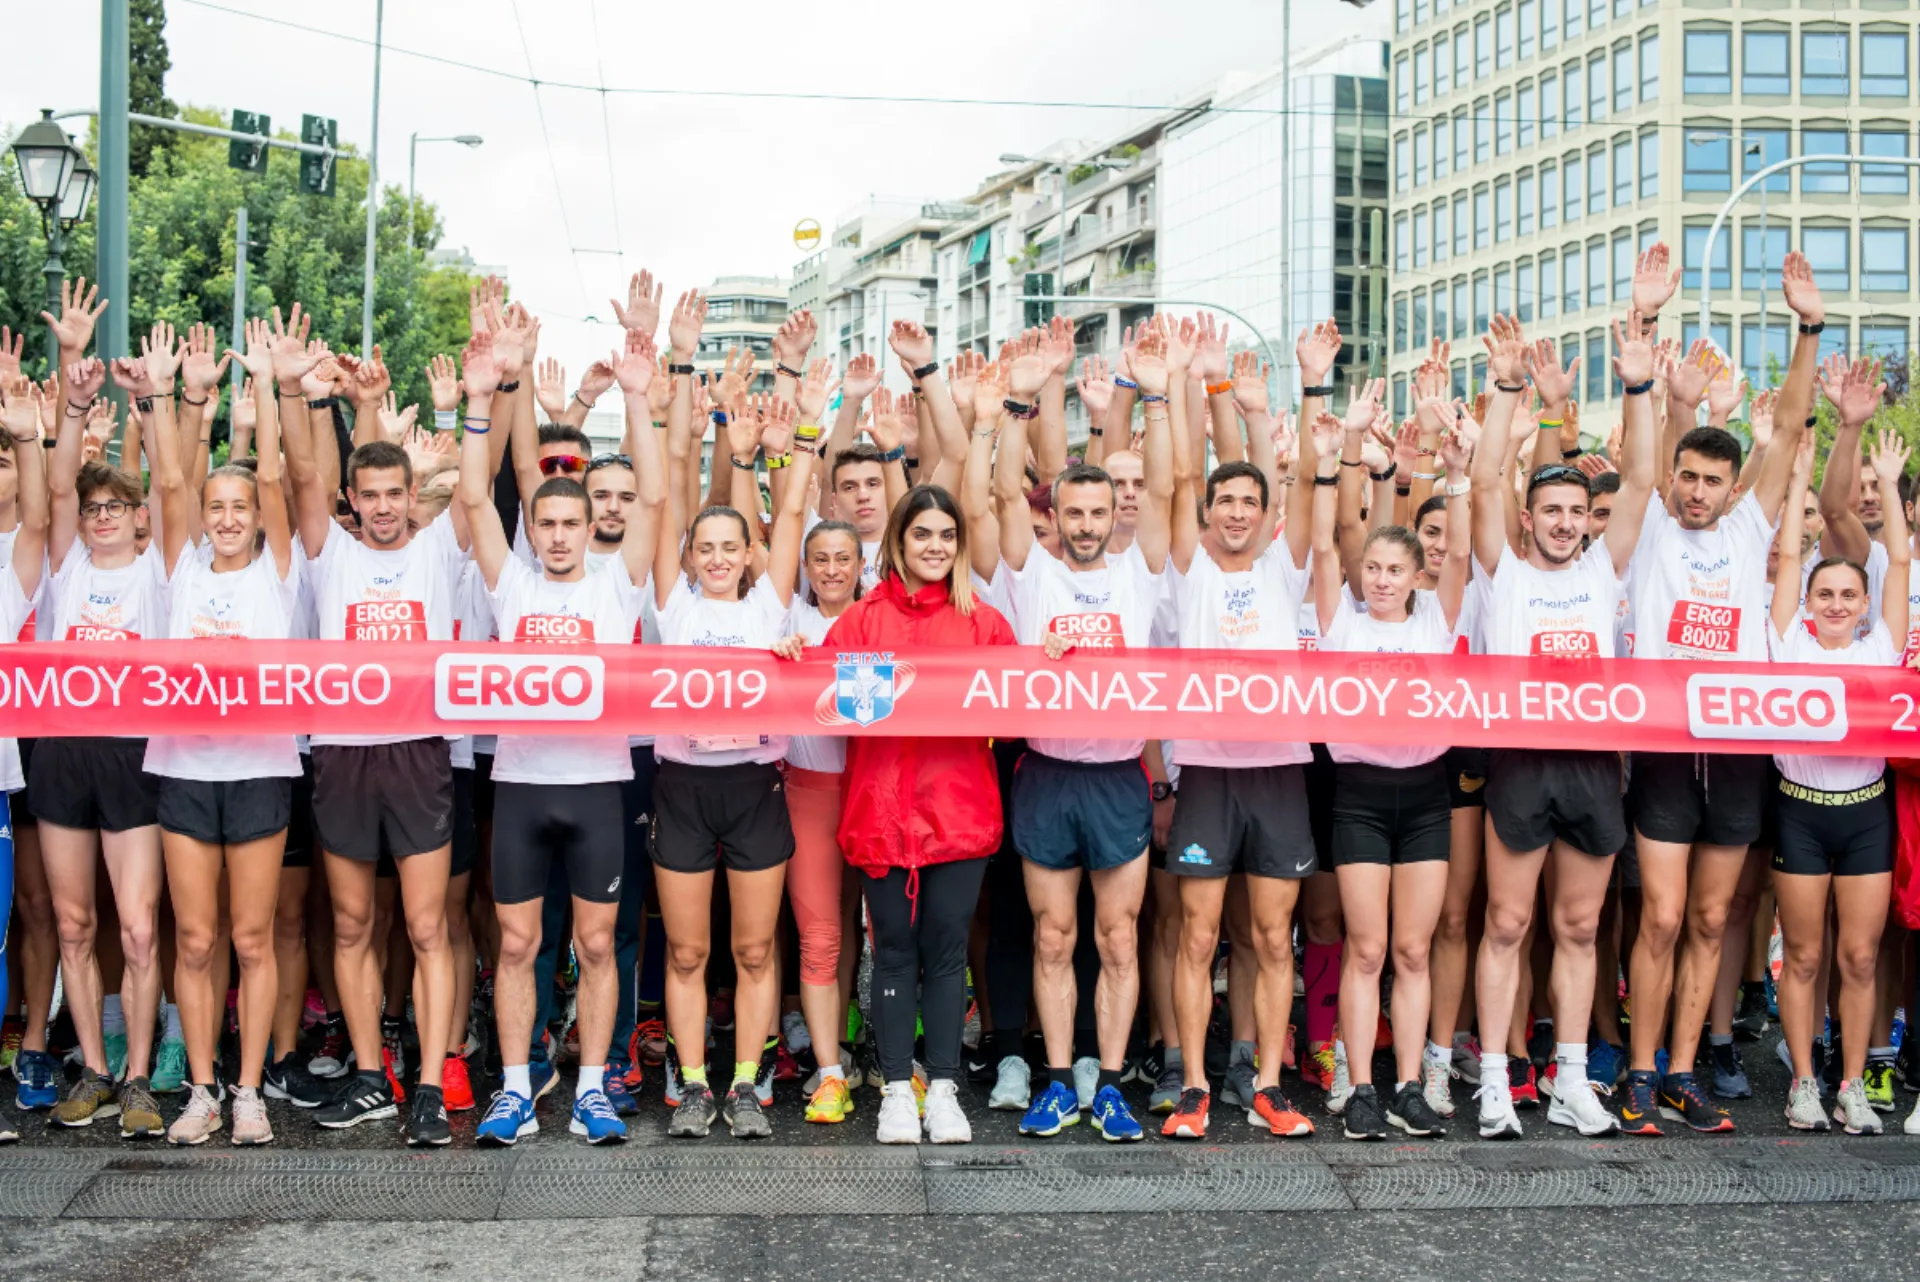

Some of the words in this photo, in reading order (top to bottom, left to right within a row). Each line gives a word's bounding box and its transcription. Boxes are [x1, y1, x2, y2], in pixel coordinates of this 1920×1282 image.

[356, 602, 412, 622] ERGO
[1055, 613, 1112, 636] ERGO
[1686, 603, 1732, 627] ERGO
[356, 623, 412, 641] 80121
[525, 617, 581, 637] ERGO
[1681, 624, 1730, 650] 80022
[1540, 633, 1590, 653] ERGO
[836, 651, 896, 665] ΣΕΓΑΣ
[0, 665, 132, 708] ΜΟΥ
[141, 662, 249, 716] 3χλμ
[258, 662, 391, 705] ERGO
[447, 664, 593, 707] ERGO
[649, 667, 768, 709] 2019
[962, 669, 1168, 712] ΑΓΩΝΑΣ
[1176, 673, 1399, 717] ΔΡΟΜΟΥ
[1406, 677, 1511, 729] 3χλμ
[1519, 681, 1647, 723] ERGO
[1698, 686, 1837, 728] ERGO
[1889, 692, 1920, 732] 2
